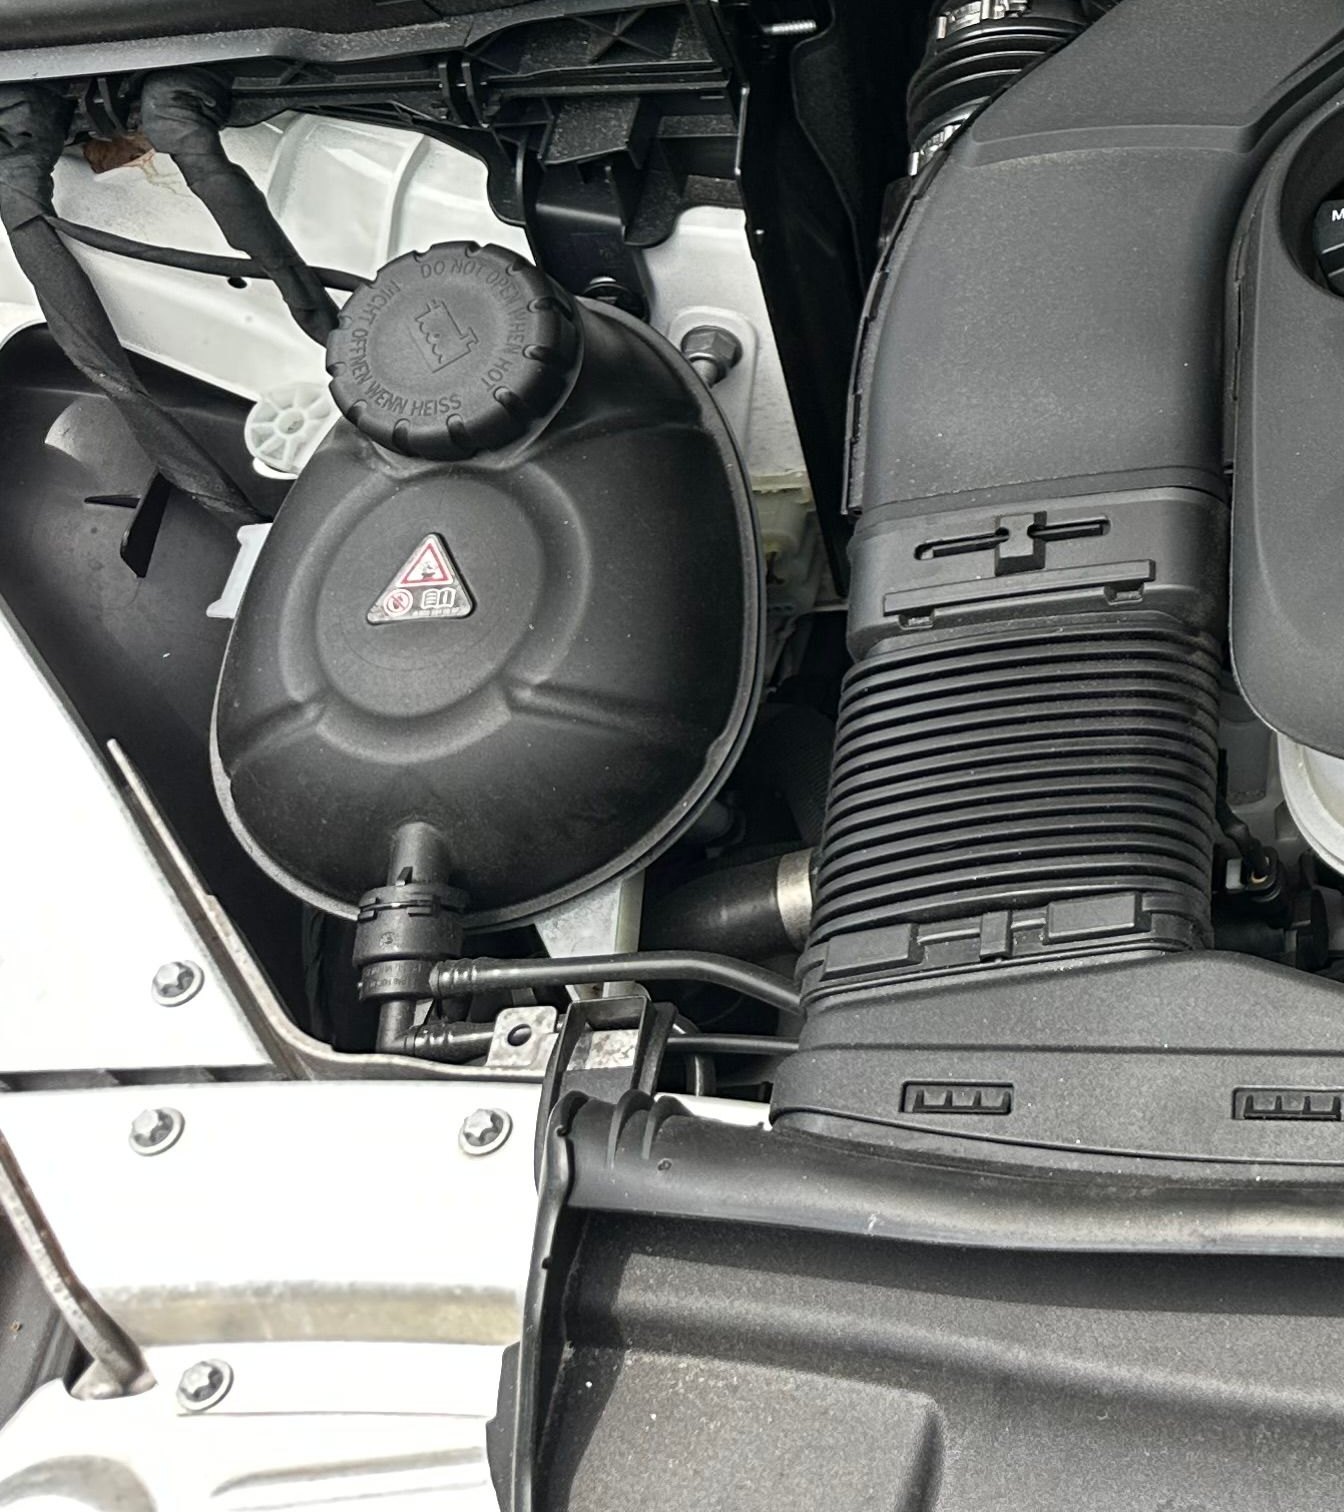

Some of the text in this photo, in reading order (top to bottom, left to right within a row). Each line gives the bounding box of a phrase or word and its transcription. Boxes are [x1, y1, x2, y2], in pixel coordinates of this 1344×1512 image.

[358, 279, 401, 325] NICHT
[420, 258, 526, 392] DO NOT OPEN WHEN HOT
[365, 380, 409, 414] WENN
[410, 392, 462, 417] HEISS
